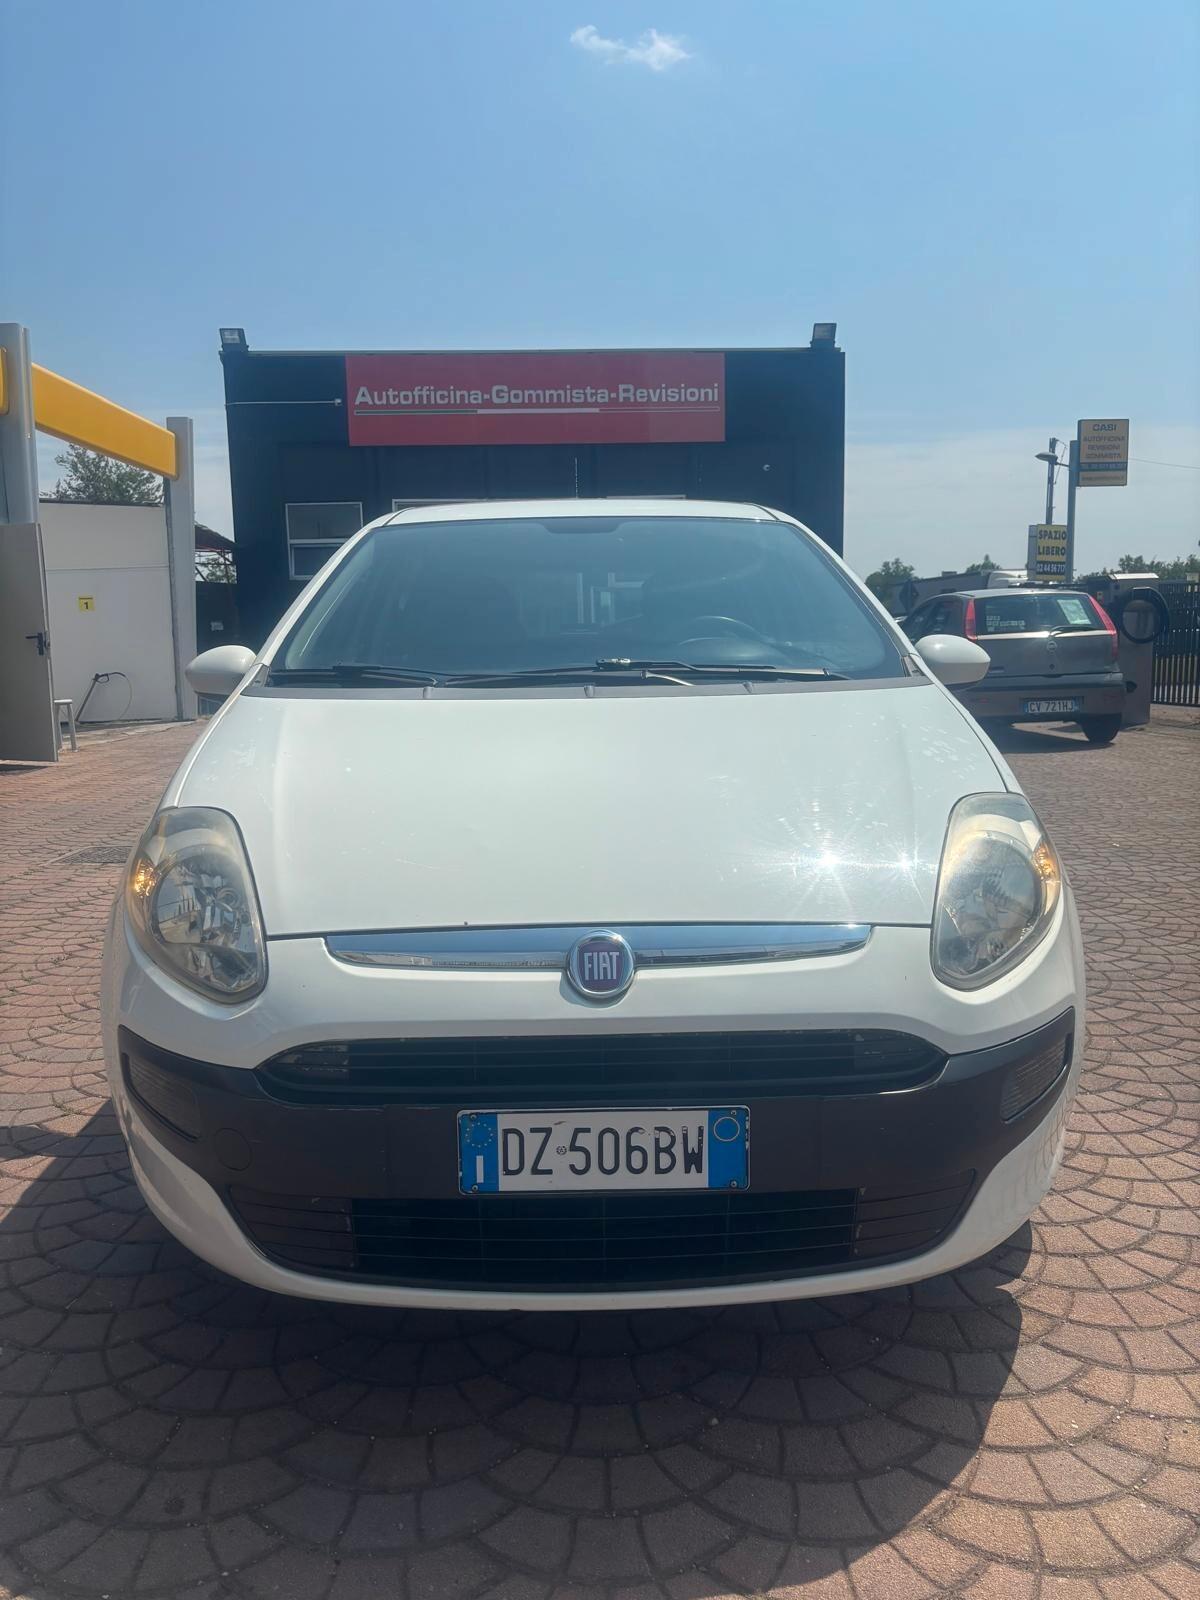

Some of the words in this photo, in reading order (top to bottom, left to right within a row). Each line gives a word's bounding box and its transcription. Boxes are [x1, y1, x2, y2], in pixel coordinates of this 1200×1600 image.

[354, 383, 719, 406] Autofficina-Gommista-Revisioni
[1038, 530, 1068, 541] SPAZIO
[1037, 545, 1066, 557] LIBERO
[83, 601, 89, 610] 1
[1030, 701, 1041, 712] CV
[1045, 700, 1074, 711] 721HJ
[584, 951, 620, 981] FIAT
[502, 1127, 554, 1176] DZ
[568, 1126, 705, 1175] 506BW
